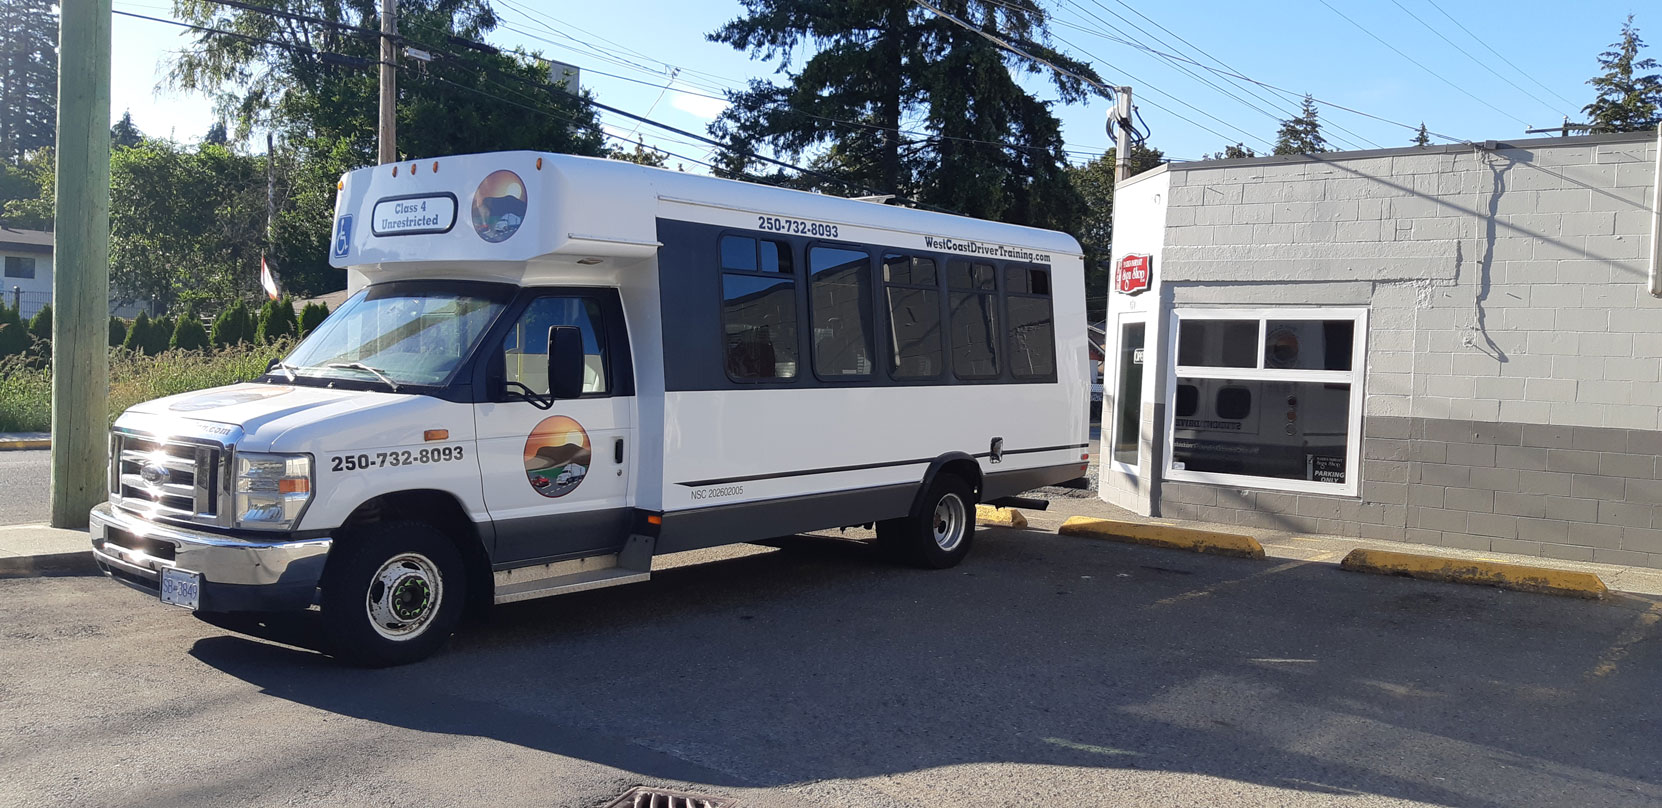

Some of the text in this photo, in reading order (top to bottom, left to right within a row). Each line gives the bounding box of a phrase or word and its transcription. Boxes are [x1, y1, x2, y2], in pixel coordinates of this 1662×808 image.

[394, 200, 427, 214] Class 4
[381, 214, 439, 230] Unrestricted
[758, 216, 839, 238] 250-732-8093
[924, 236, 1051, 263] WestCoastDriverTraining.com
[330, 445, 464, 472] 250-732-8093
[1314, 470, 1345, 479] PARKING
[1320, 476, 1339, 484] ONLY
[690, 485, 744, 500] NSC 202602005
